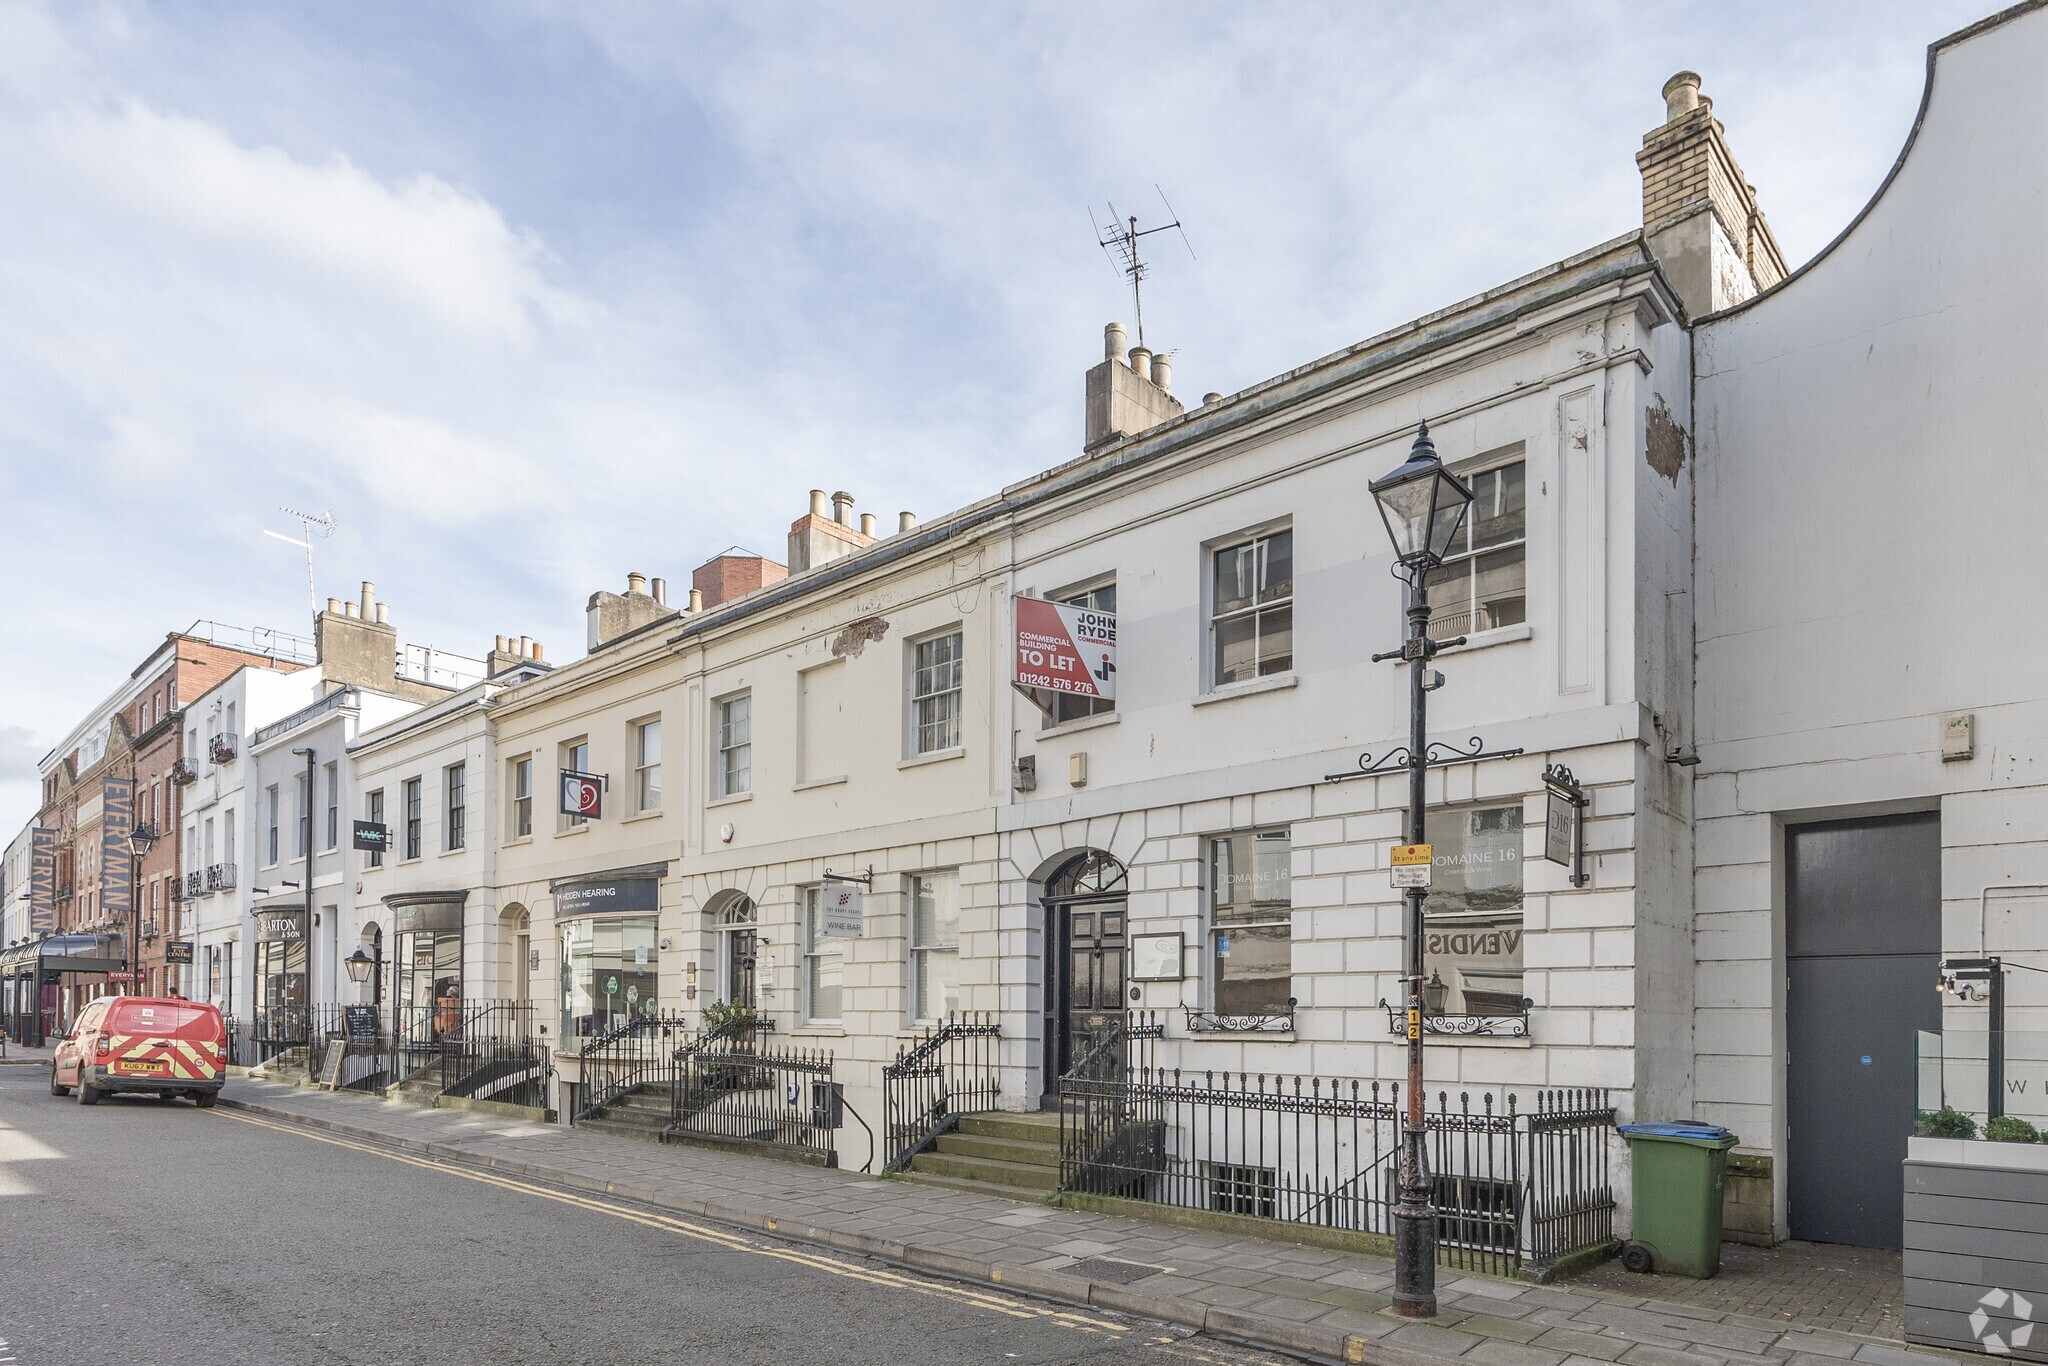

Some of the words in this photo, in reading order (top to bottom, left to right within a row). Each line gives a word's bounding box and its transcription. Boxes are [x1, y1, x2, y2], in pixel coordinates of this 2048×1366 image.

[1078, 612, 1116, 629] JOHN
[1020, 631, 1071, 647] COMMERCIAL
[1078, 624, 1116, 641] RYDE
[1020, 639, 1057, 652] BUILDING
[1078, 636, 1116, 647] COMMERCIAL
[1020, 648, 1044, 666] TO
[1049, 653, 1076, 672] LET
[1020, 672, 1050, 687] 01242
[1053, 677, 1071, 690] 576
[1075, 680, 1093, 694] 276
[104, 782, 130, 906] EVERYMAN
[1432, 851, 1493, 867] OMAINE
[1498, 848, 1516, 862] 16
[32, 832, 54, 929] EVERYMAN
[1274, 868, 1288, 881] 16
[562, 889, 581, 901] HIDDEN
[581, 887, 616, 898] HEARING
[827, 921, 846, 930] WINE
[846, 923, 861, 931] BAR
[287, 930, 300, 938] SON
[1411, 1012, 1416, 1022] 1
[1410, 1027, 1417, 1037] 2
